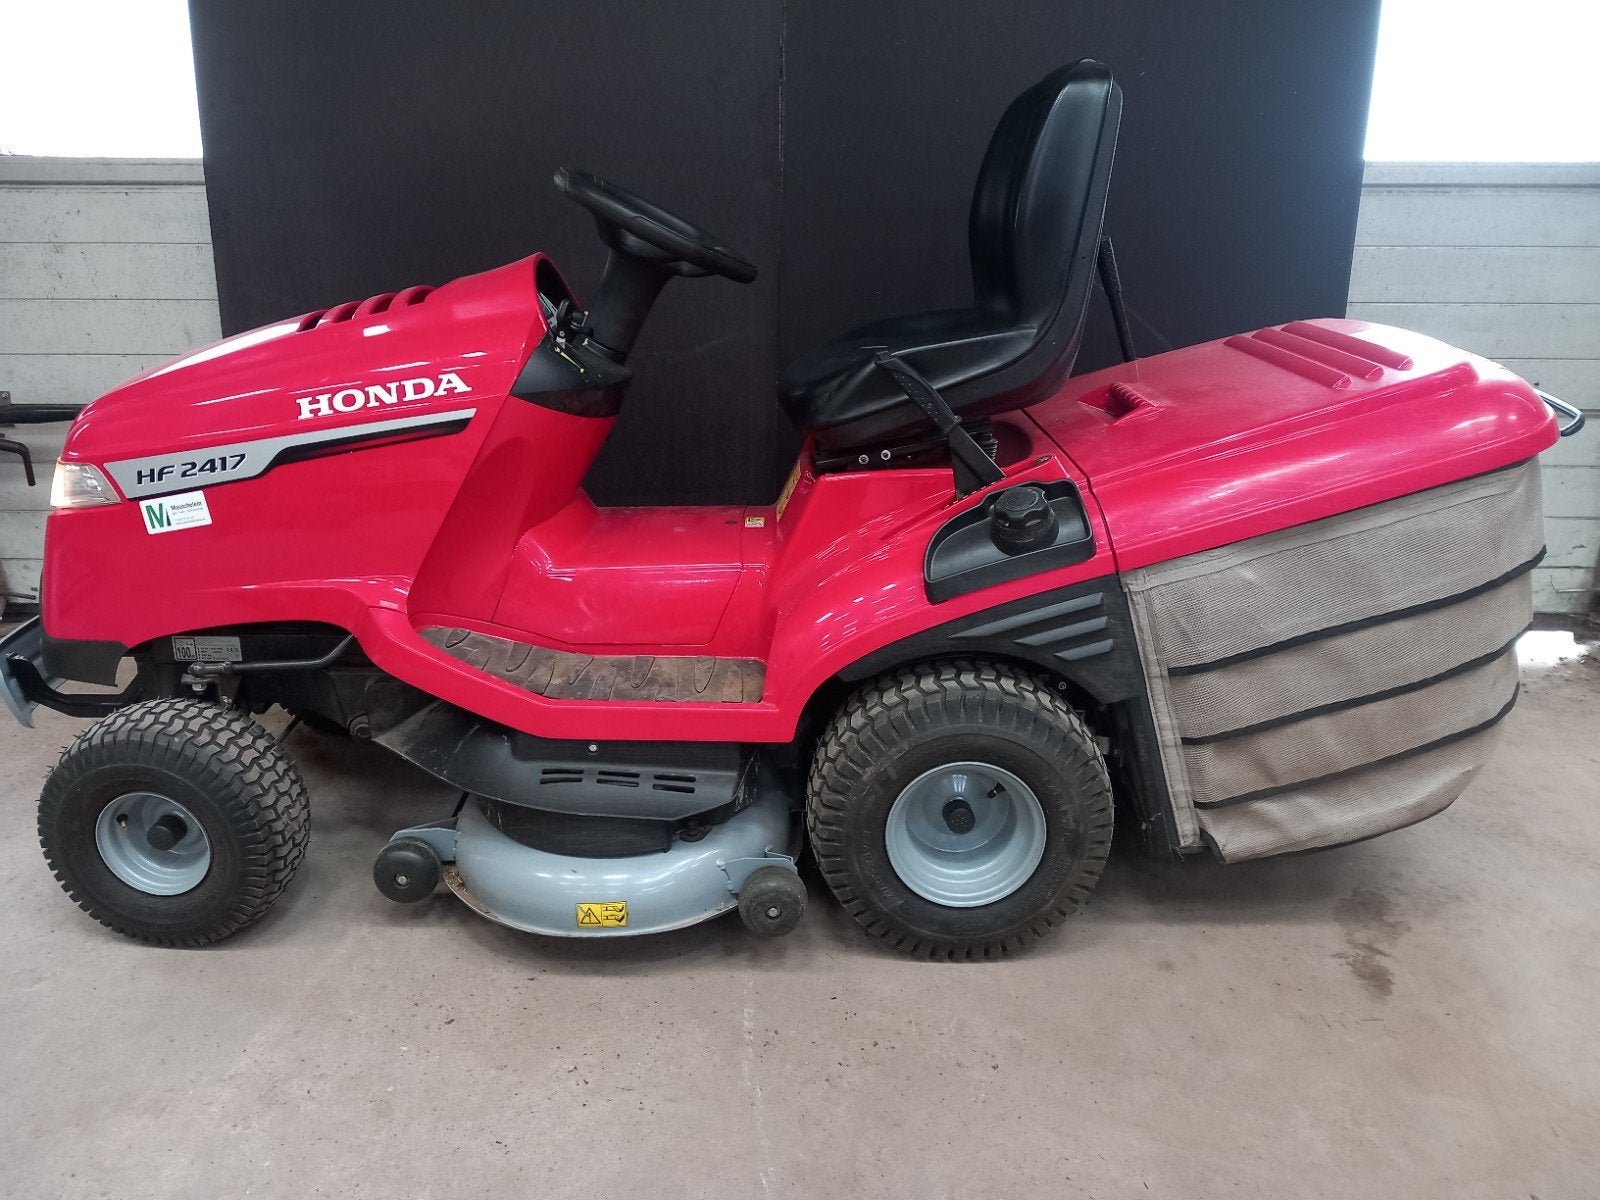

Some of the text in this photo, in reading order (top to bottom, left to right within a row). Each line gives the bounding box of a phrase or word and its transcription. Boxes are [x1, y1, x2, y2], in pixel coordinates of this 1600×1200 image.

[296, 372, 472, 420] HONDA
[137, 453, 247, 485] HF 2417
